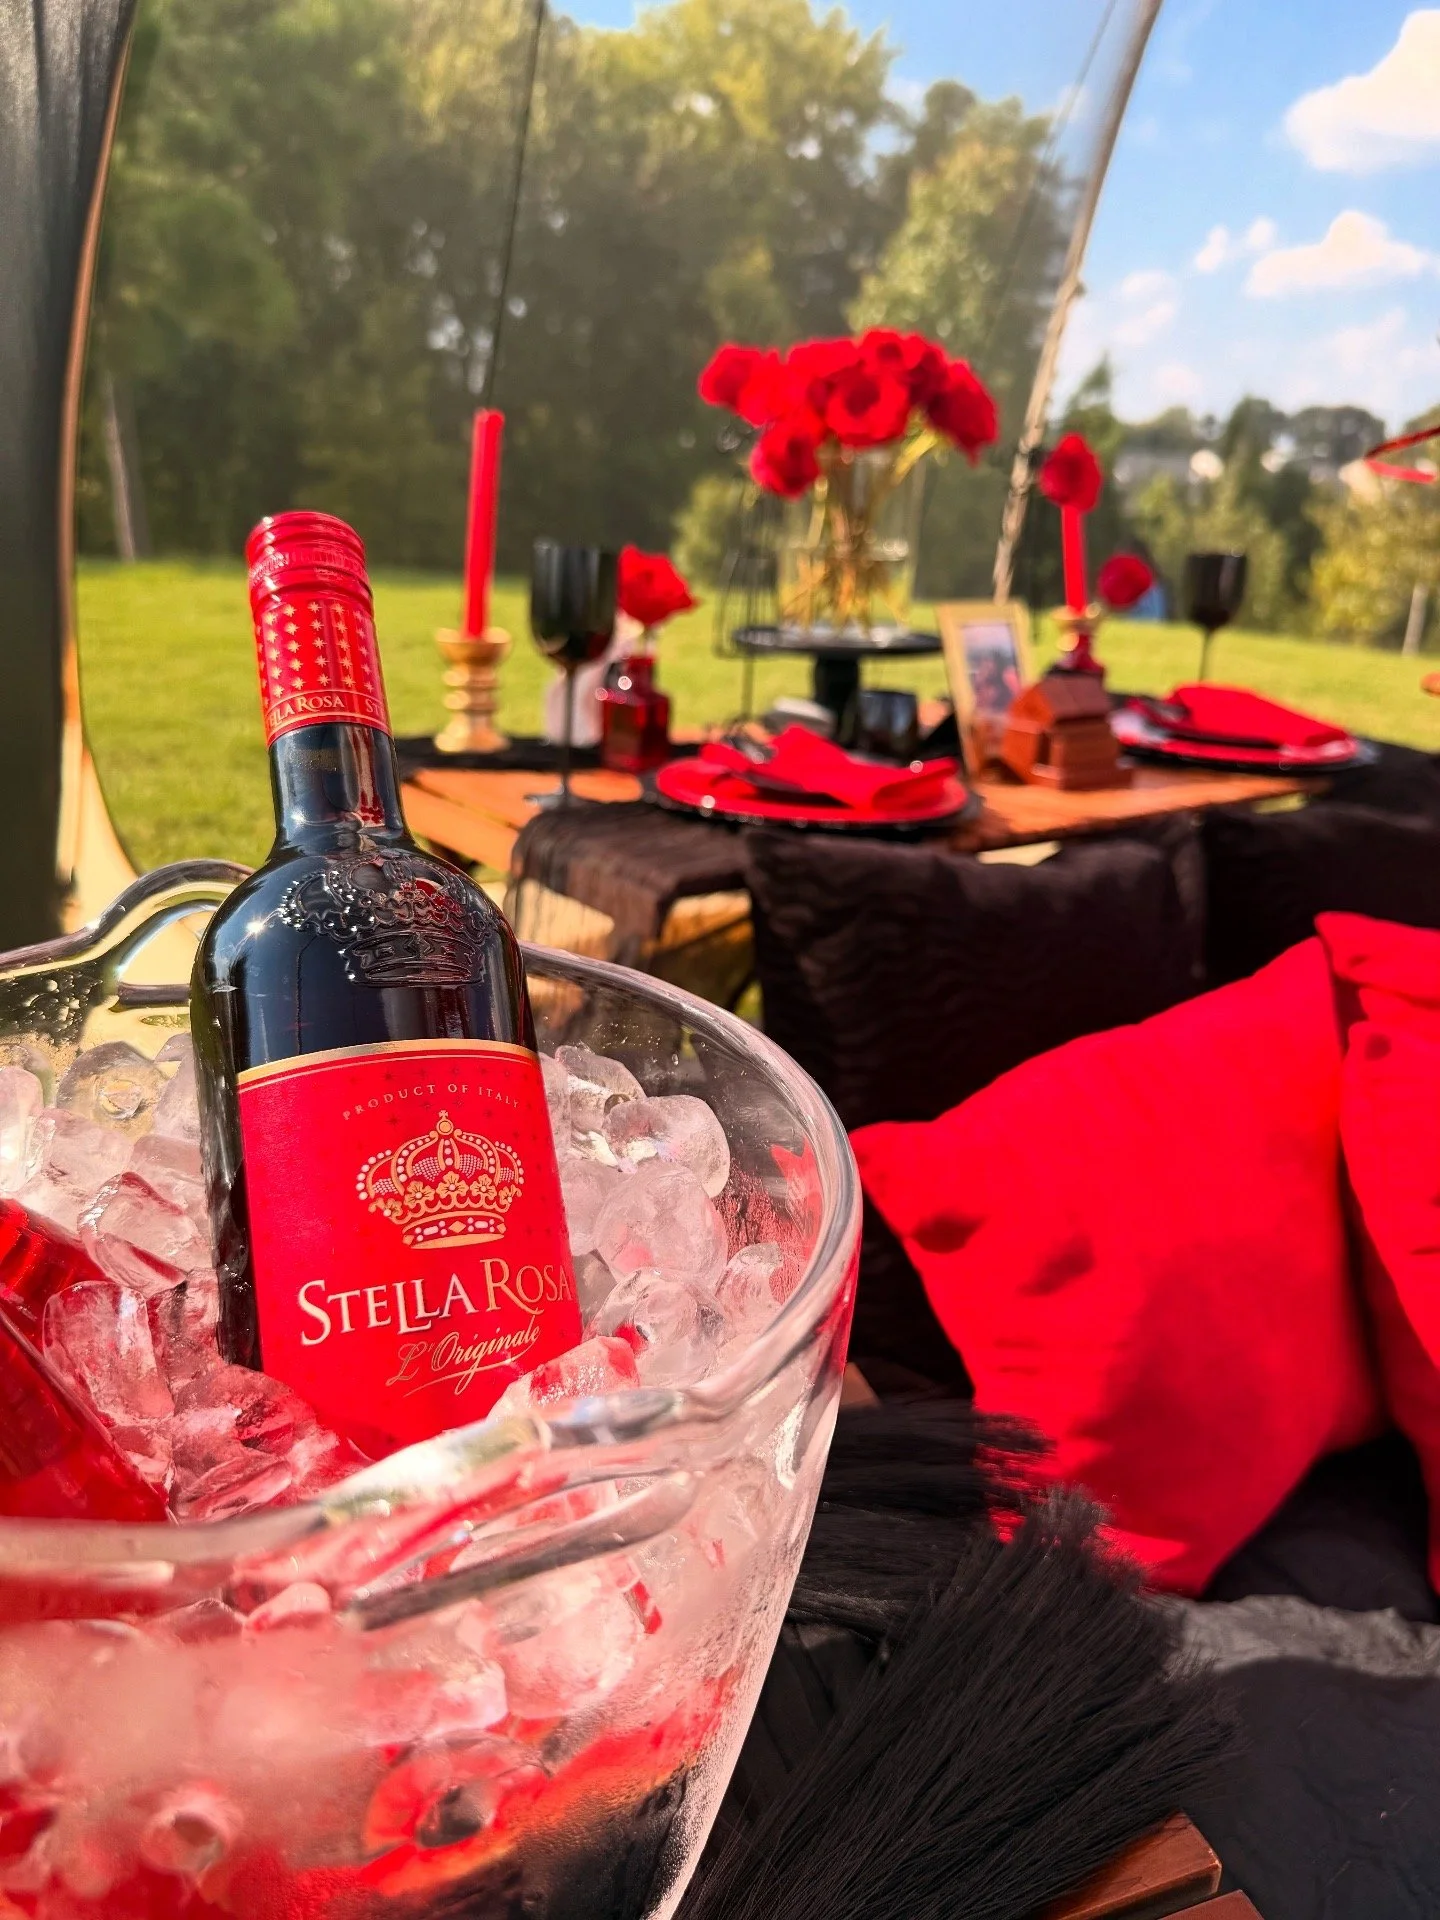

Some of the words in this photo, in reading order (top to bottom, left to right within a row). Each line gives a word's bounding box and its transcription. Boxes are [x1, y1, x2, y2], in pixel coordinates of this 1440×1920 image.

[269, 701, 295, 727] ELLA
[295, 695, 345, 713] ROSA
[343, 1084, 436, 1120] PRODUCT
[447, 1083, 468, 1094] OF
[478, 1086, 519, 1108] ITALY
[297, 1272, 480, 1346] STELLA
[480, 1257, 573, 1315] ROSA
[385, 1315, 541, 1396] L'Originale
